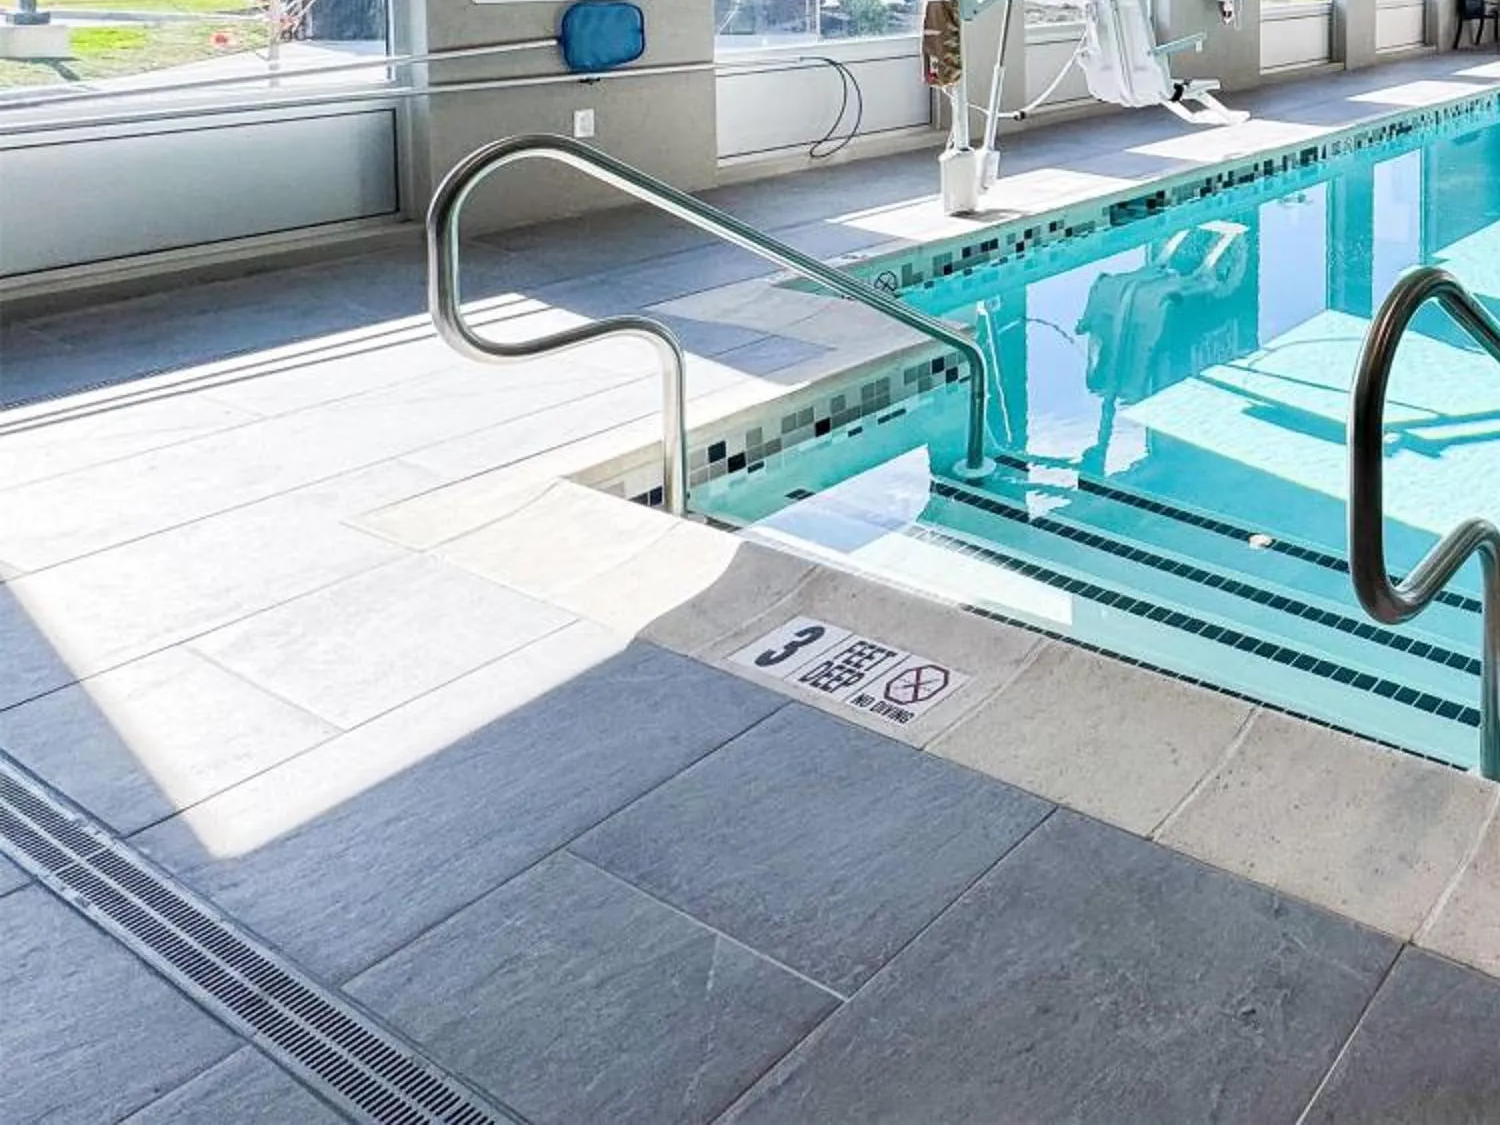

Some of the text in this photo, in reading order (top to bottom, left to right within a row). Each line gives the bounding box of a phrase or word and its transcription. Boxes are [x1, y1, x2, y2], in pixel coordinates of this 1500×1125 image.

[754, 625, 826, 667] 3
[834, 640, 898, 672] FEET
[798, 660, 867, 693] DEEP
[851, 693, 916, 725] NO DIVING
